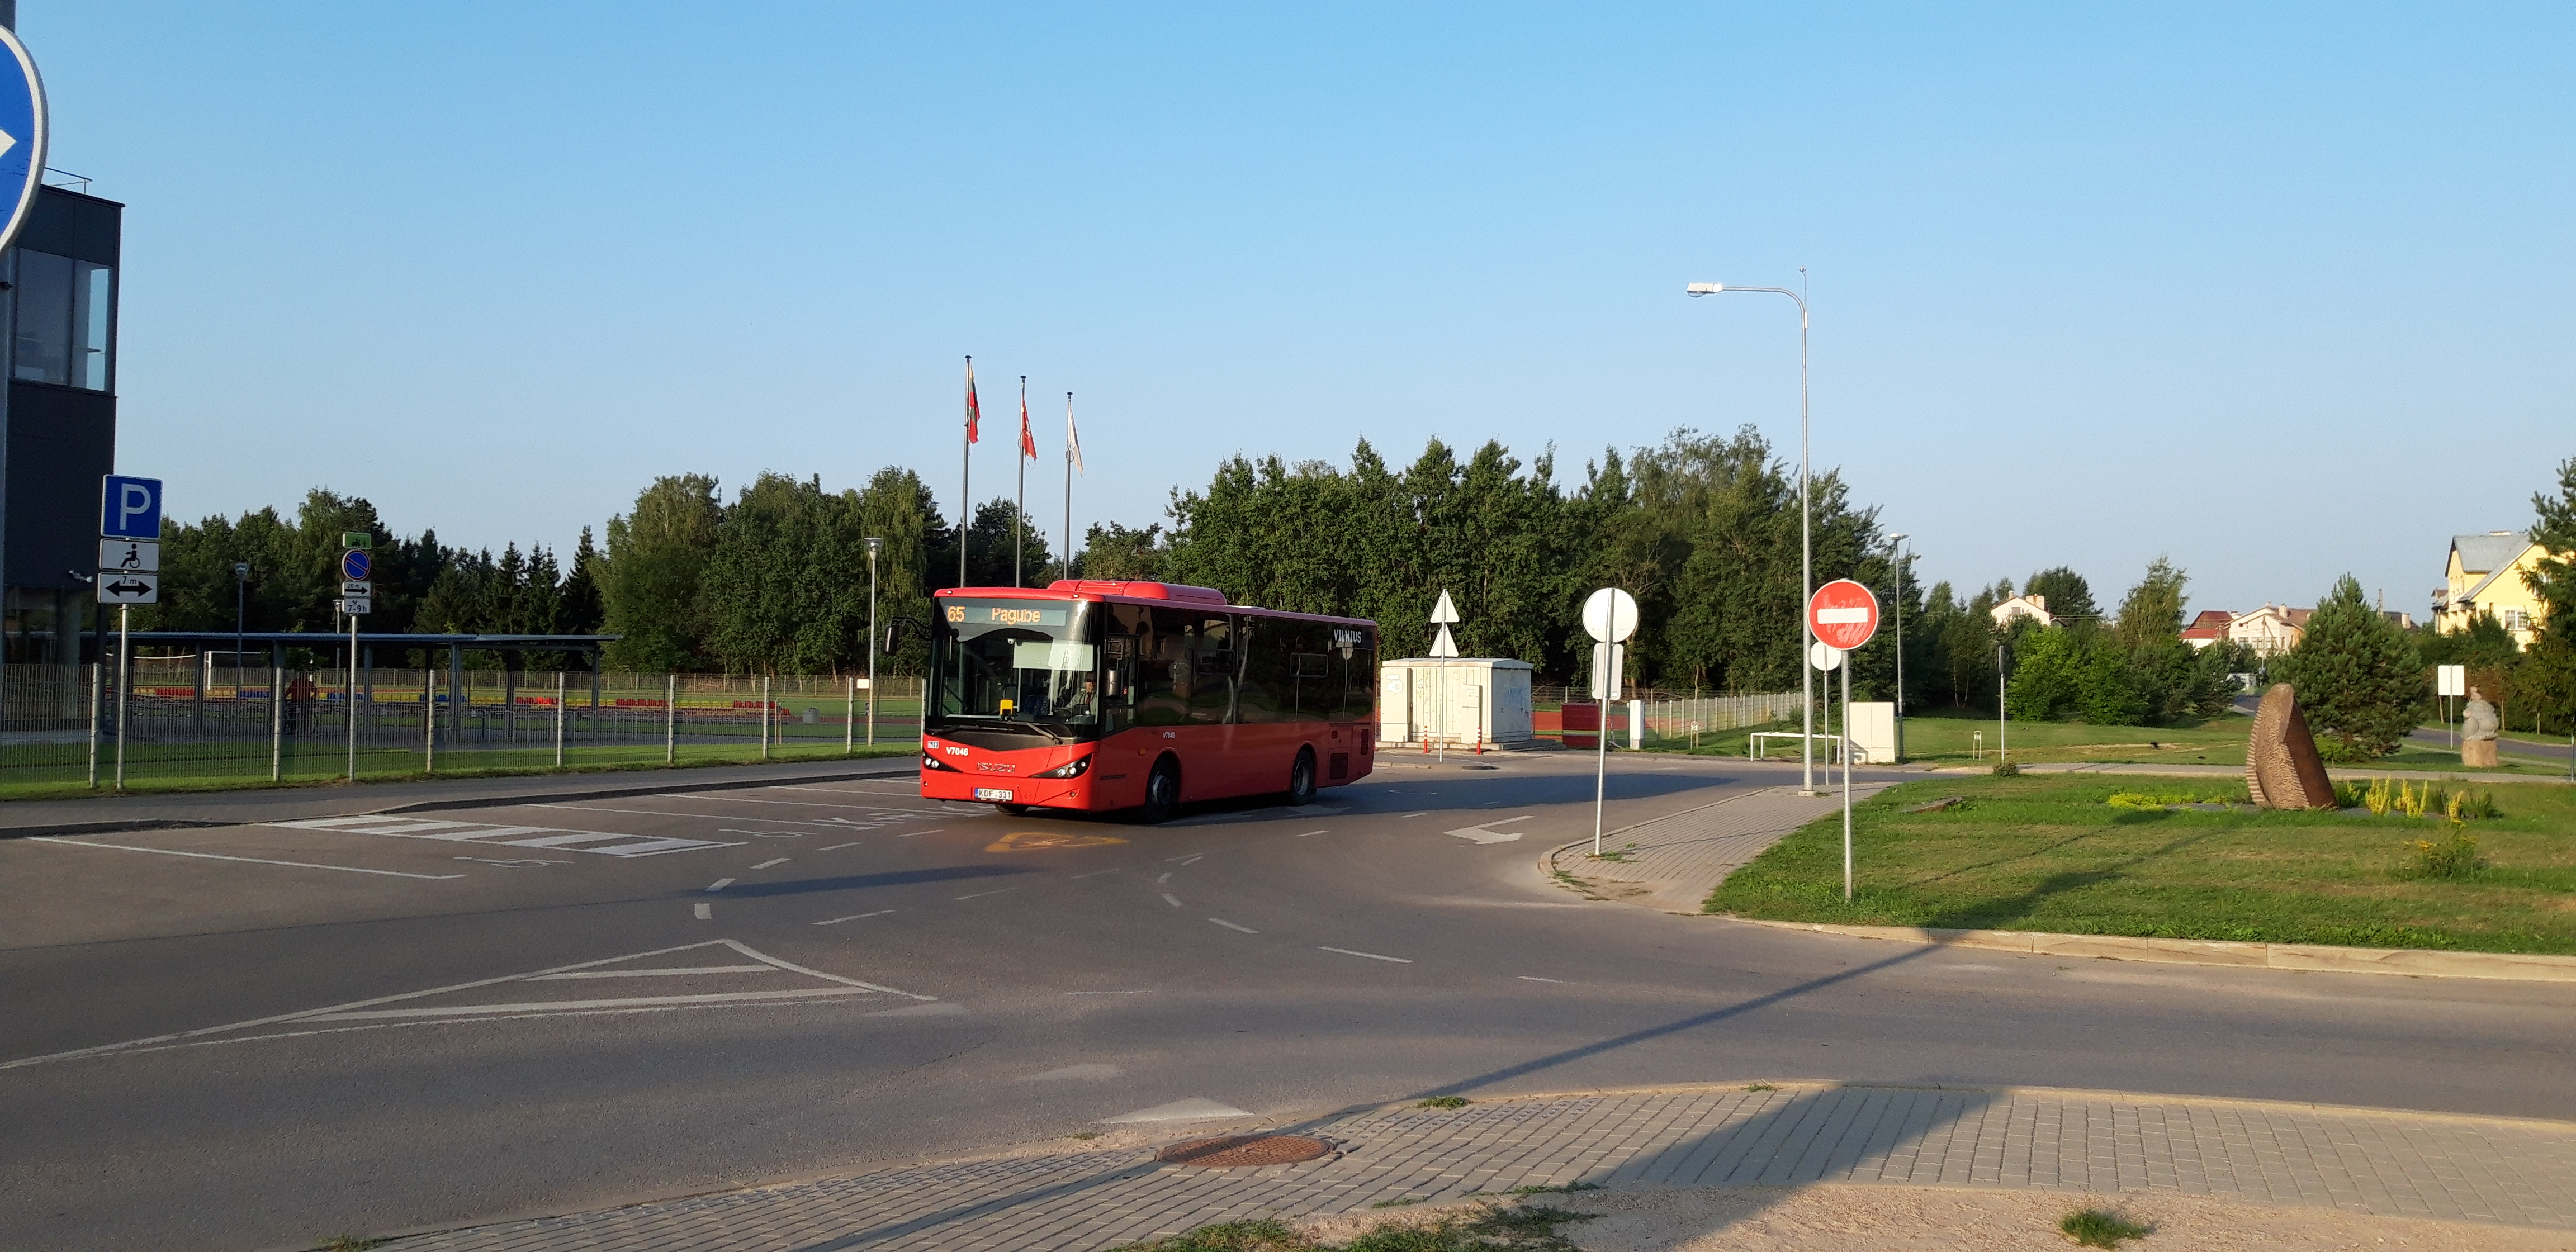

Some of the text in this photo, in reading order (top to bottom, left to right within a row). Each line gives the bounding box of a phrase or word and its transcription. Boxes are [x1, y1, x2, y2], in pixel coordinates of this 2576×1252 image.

[119, 483, 151, 530] P
[122, 576, 127, 585] 7
[948, 606, 966, 622] 65
[991, 608, 1041, 625] Pagube
[1333, 629, 1361, 643] VILNIUS
[946, 746, 968, 756] V7046
[977, 762, 1015, 772] ISUZU
